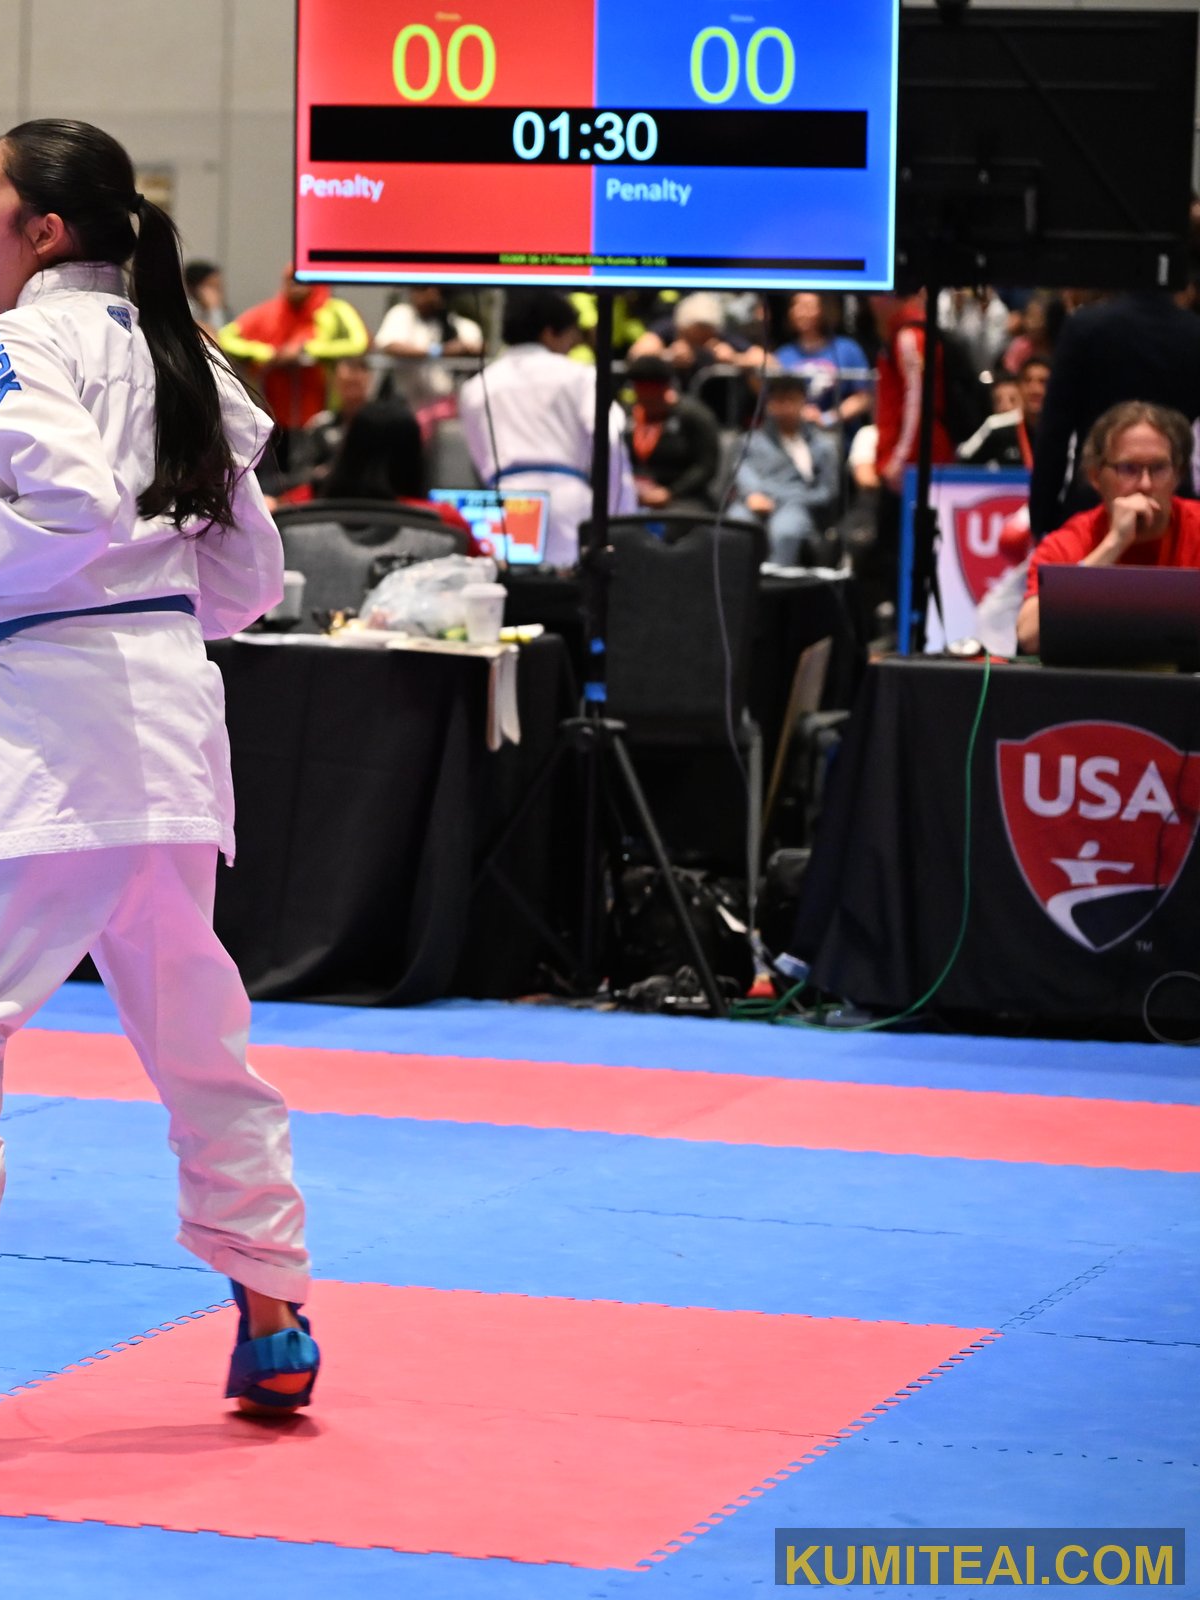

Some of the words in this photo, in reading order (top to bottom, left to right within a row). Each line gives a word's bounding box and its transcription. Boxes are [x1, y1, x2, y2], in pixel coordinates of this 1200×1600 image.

[391, 23, 497, 102] 00
[690, 26, 796, 105] 00
[511, 110, 659, 162] 01:30
[300, 174, 385, 203] Penalty
[605, 178, 692, 207] Penalty
[1023, 752, 1180, 824] USA
